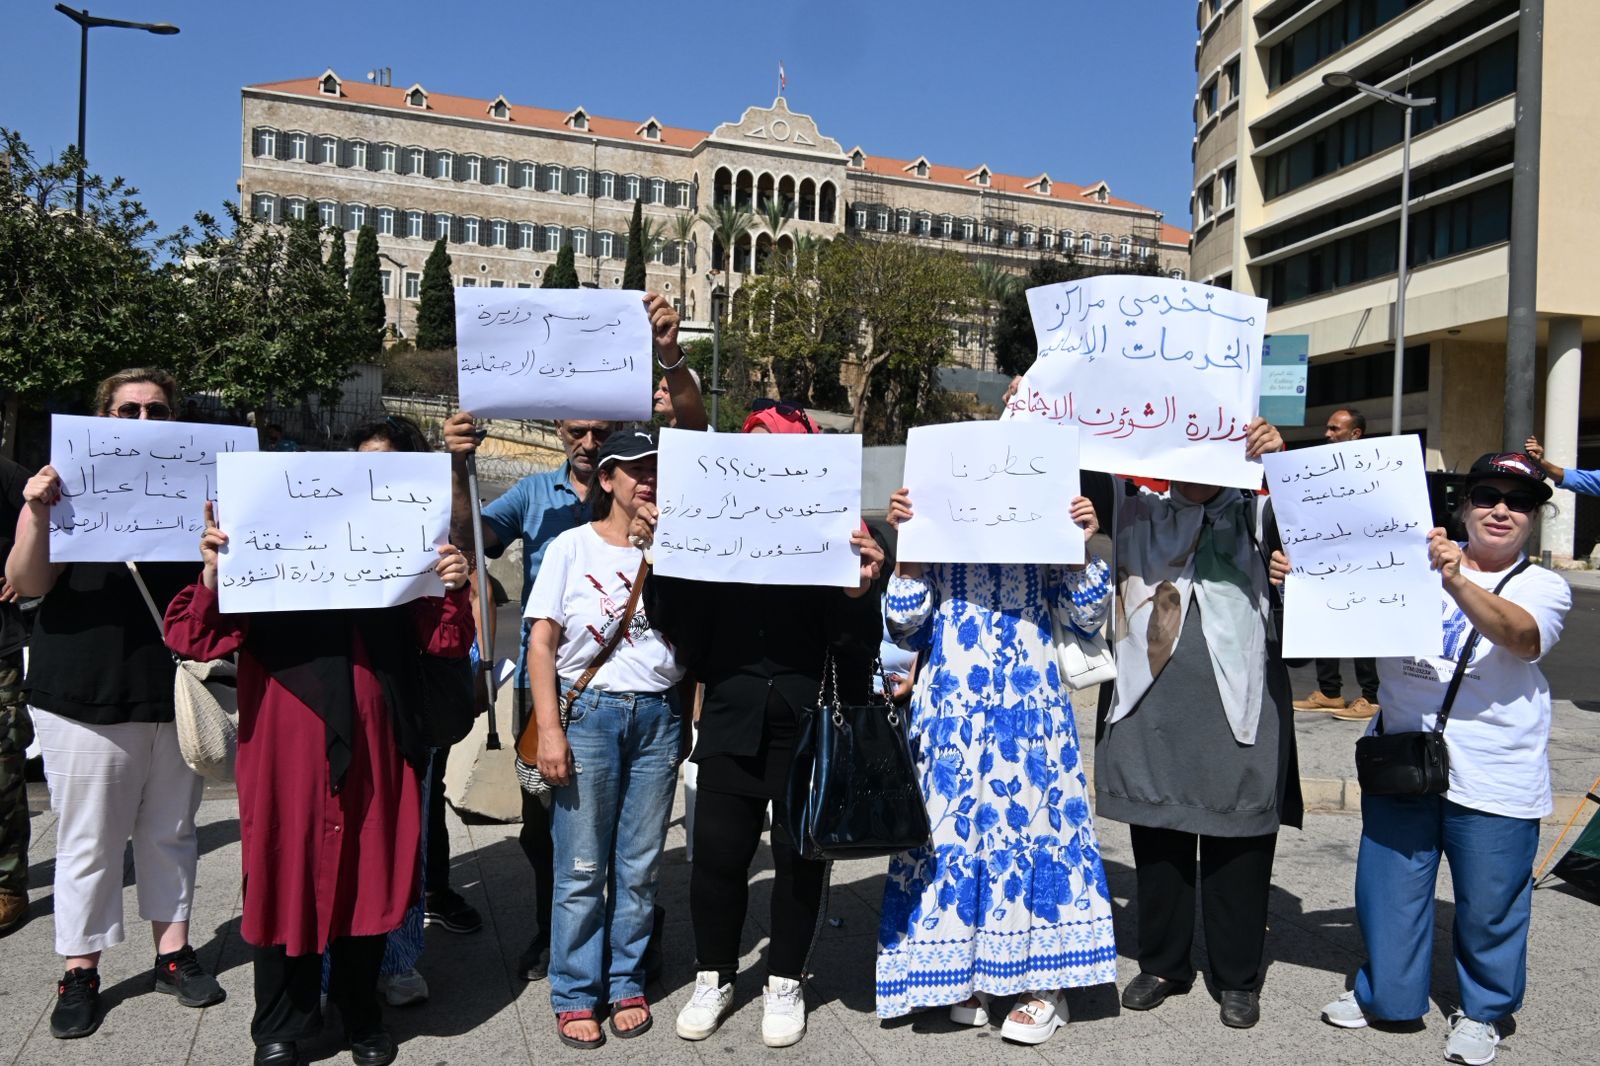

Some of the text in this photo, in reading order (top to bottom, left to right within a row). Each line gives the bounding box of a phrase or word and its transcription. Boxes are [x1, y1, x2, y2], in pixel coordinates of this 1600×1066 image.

[477, 303, 533, 328] وزيرة
[1046, 284, 1106, 332] مراكز
[1121, 325, 1252, 374] الخدمات
[538, 355, 635, 378] الشؤون
[1354, 448, 1403, 472] وزارة
[285, 468, 433, 511] بدنا حقنا
[660, 493, 702, 518] وزارة
[765, 503, 849, 524] مستخدمي
[113, 515, 184, 533] الشؤون
[1363, 516, 1419, 539] موظفين
[347, 521, 406, 559] بدنا
[749, 541, 830, 559] الشؤون
[222, 563, 286, 588] الشؤون
[290, 560, 336, 583] وزارة
